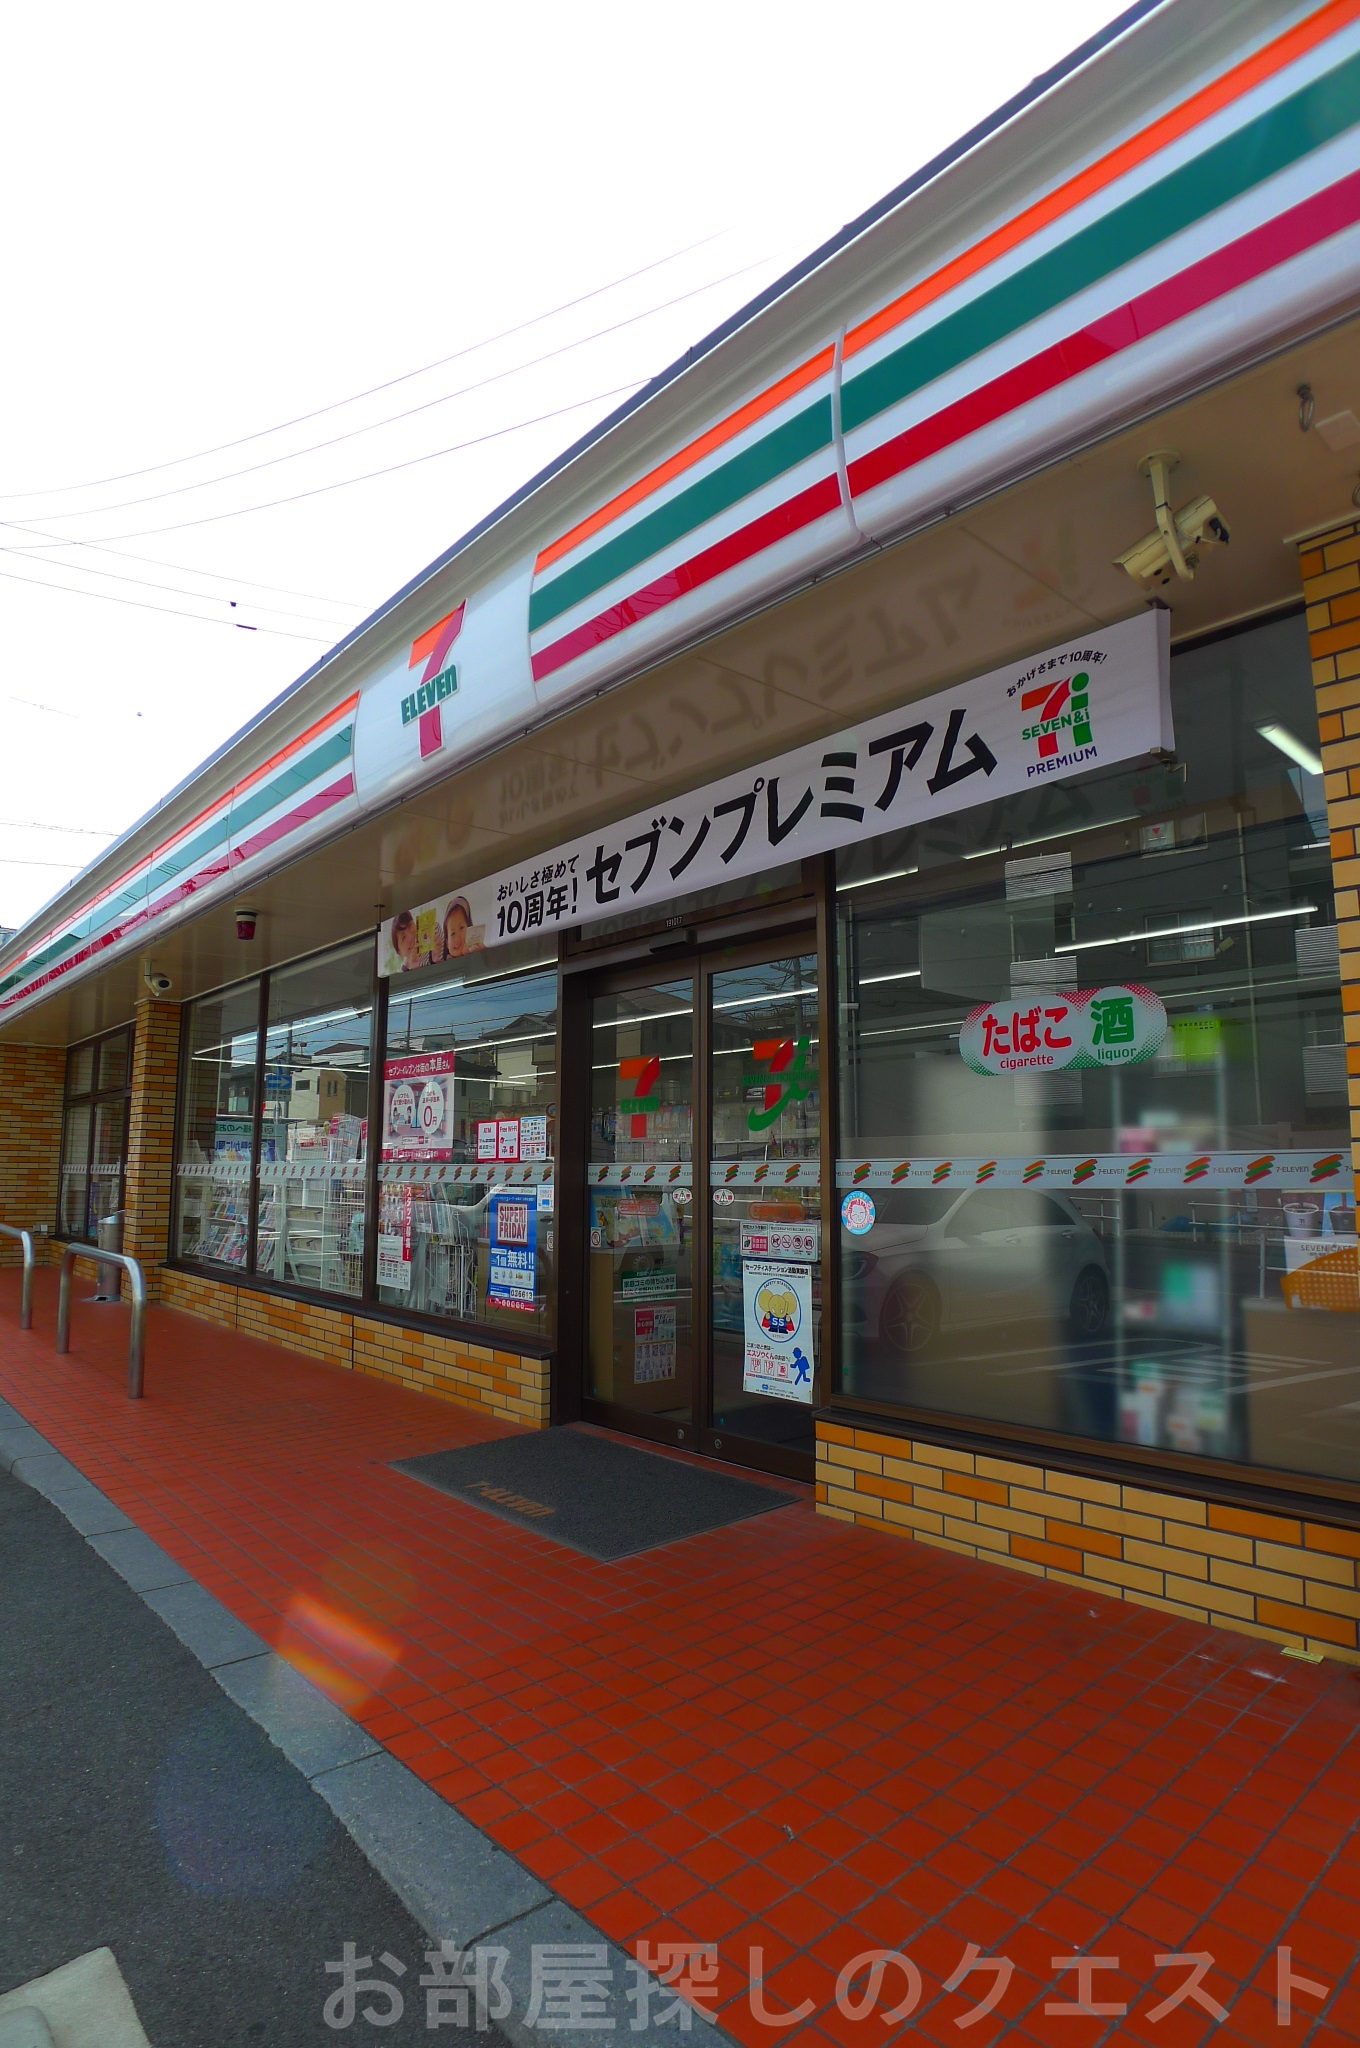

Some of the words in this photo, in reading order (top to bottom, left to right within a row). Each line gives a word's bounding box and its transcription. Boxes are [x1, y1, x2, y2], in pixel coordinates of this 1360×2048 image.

[407, 598, 467, 759] 7
[1026, 745, 1099, 778] PREMIUM
[586, 708, 999, 906] セブンプレミアム
[496, 854, 580, 902] おいしさ極めて
[496, 876, 579, 938] 10周年!
[981, 1006, 1073, 1058] たばこ
[1090, 996, 1135, 1046] 酒
[1000, 1054, 1055, 1071] cigarette
[1097, 1045, 1137, 1062] liquor
[499, 1221, 527, 1240] FRIDAY
[1300, 1244, 1327, 1252] SEVEN
[771, 1317, 785, 1326] SS
